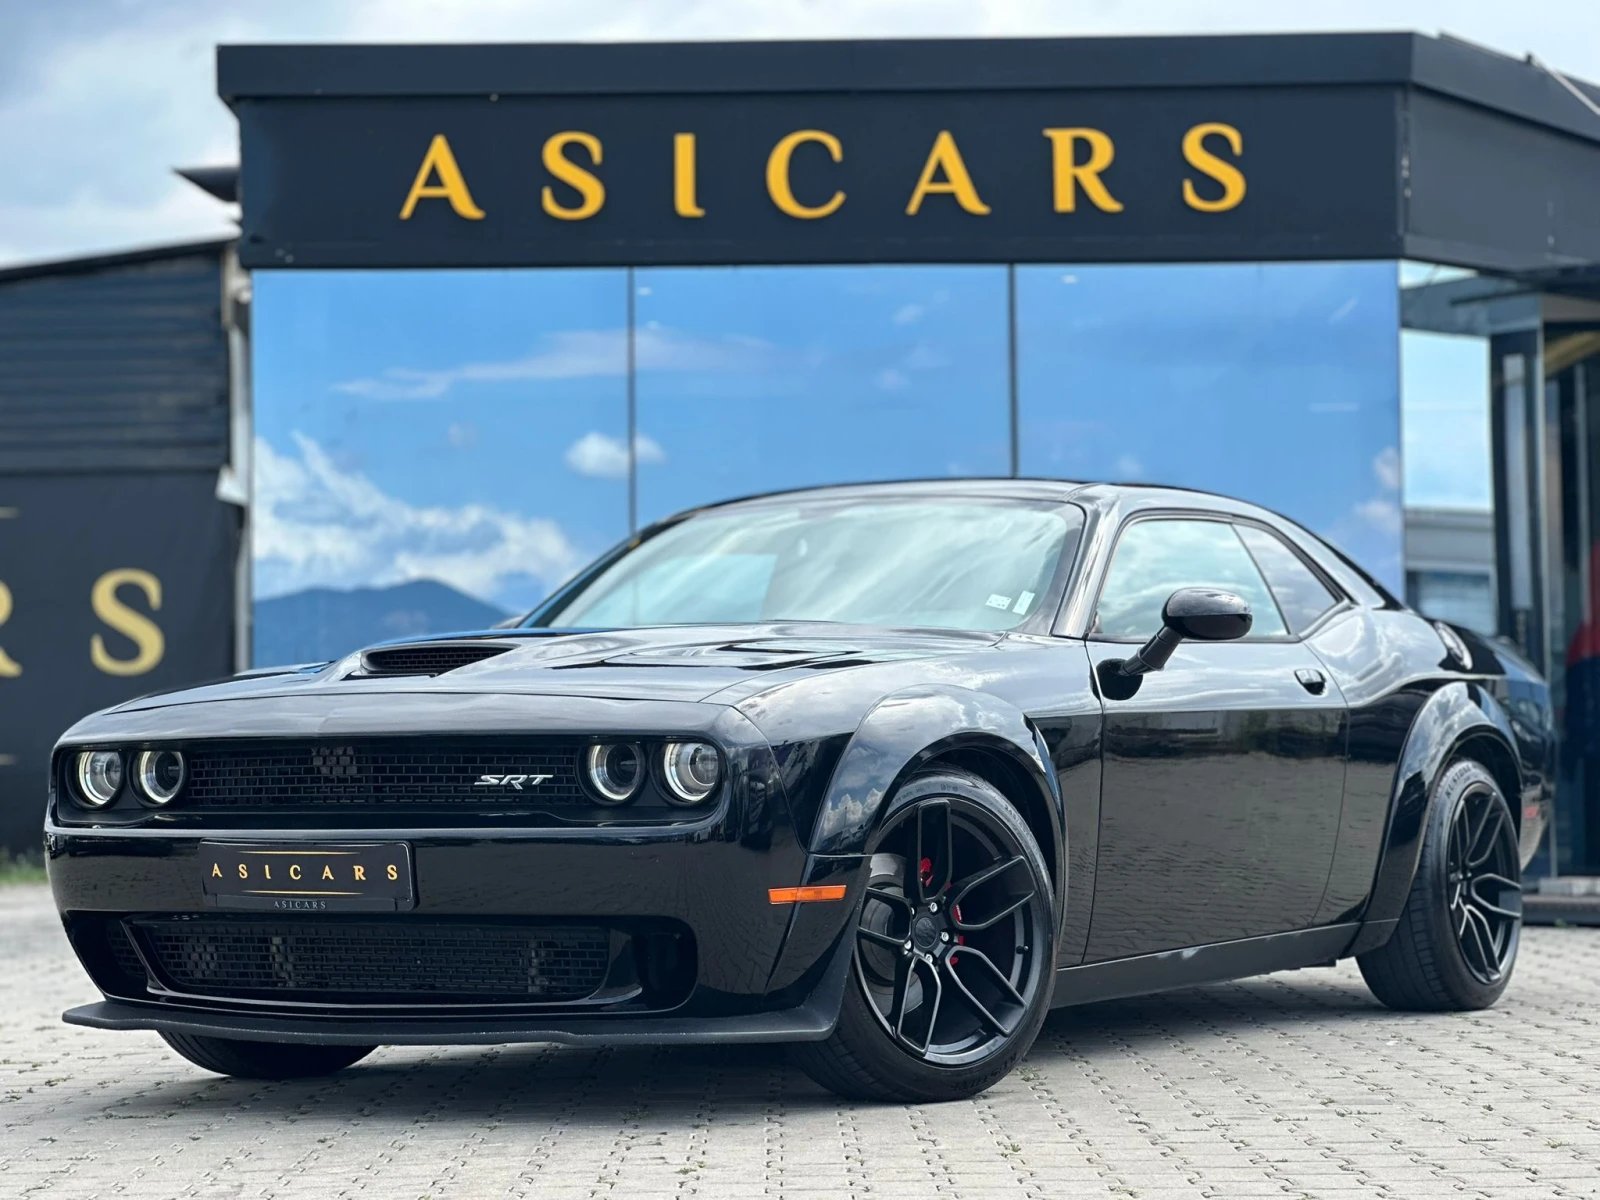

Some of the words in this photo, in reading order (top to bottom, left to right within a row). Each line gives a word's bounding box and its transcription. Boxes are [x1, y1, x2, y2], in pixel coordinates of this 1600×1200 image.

[400, 122, 1247, 220] ASICARS
[474, 774, 554, 790] SRT
[211, 863, 399, 881] ASICARS
[273, 900, 327, 909] ASICARS
